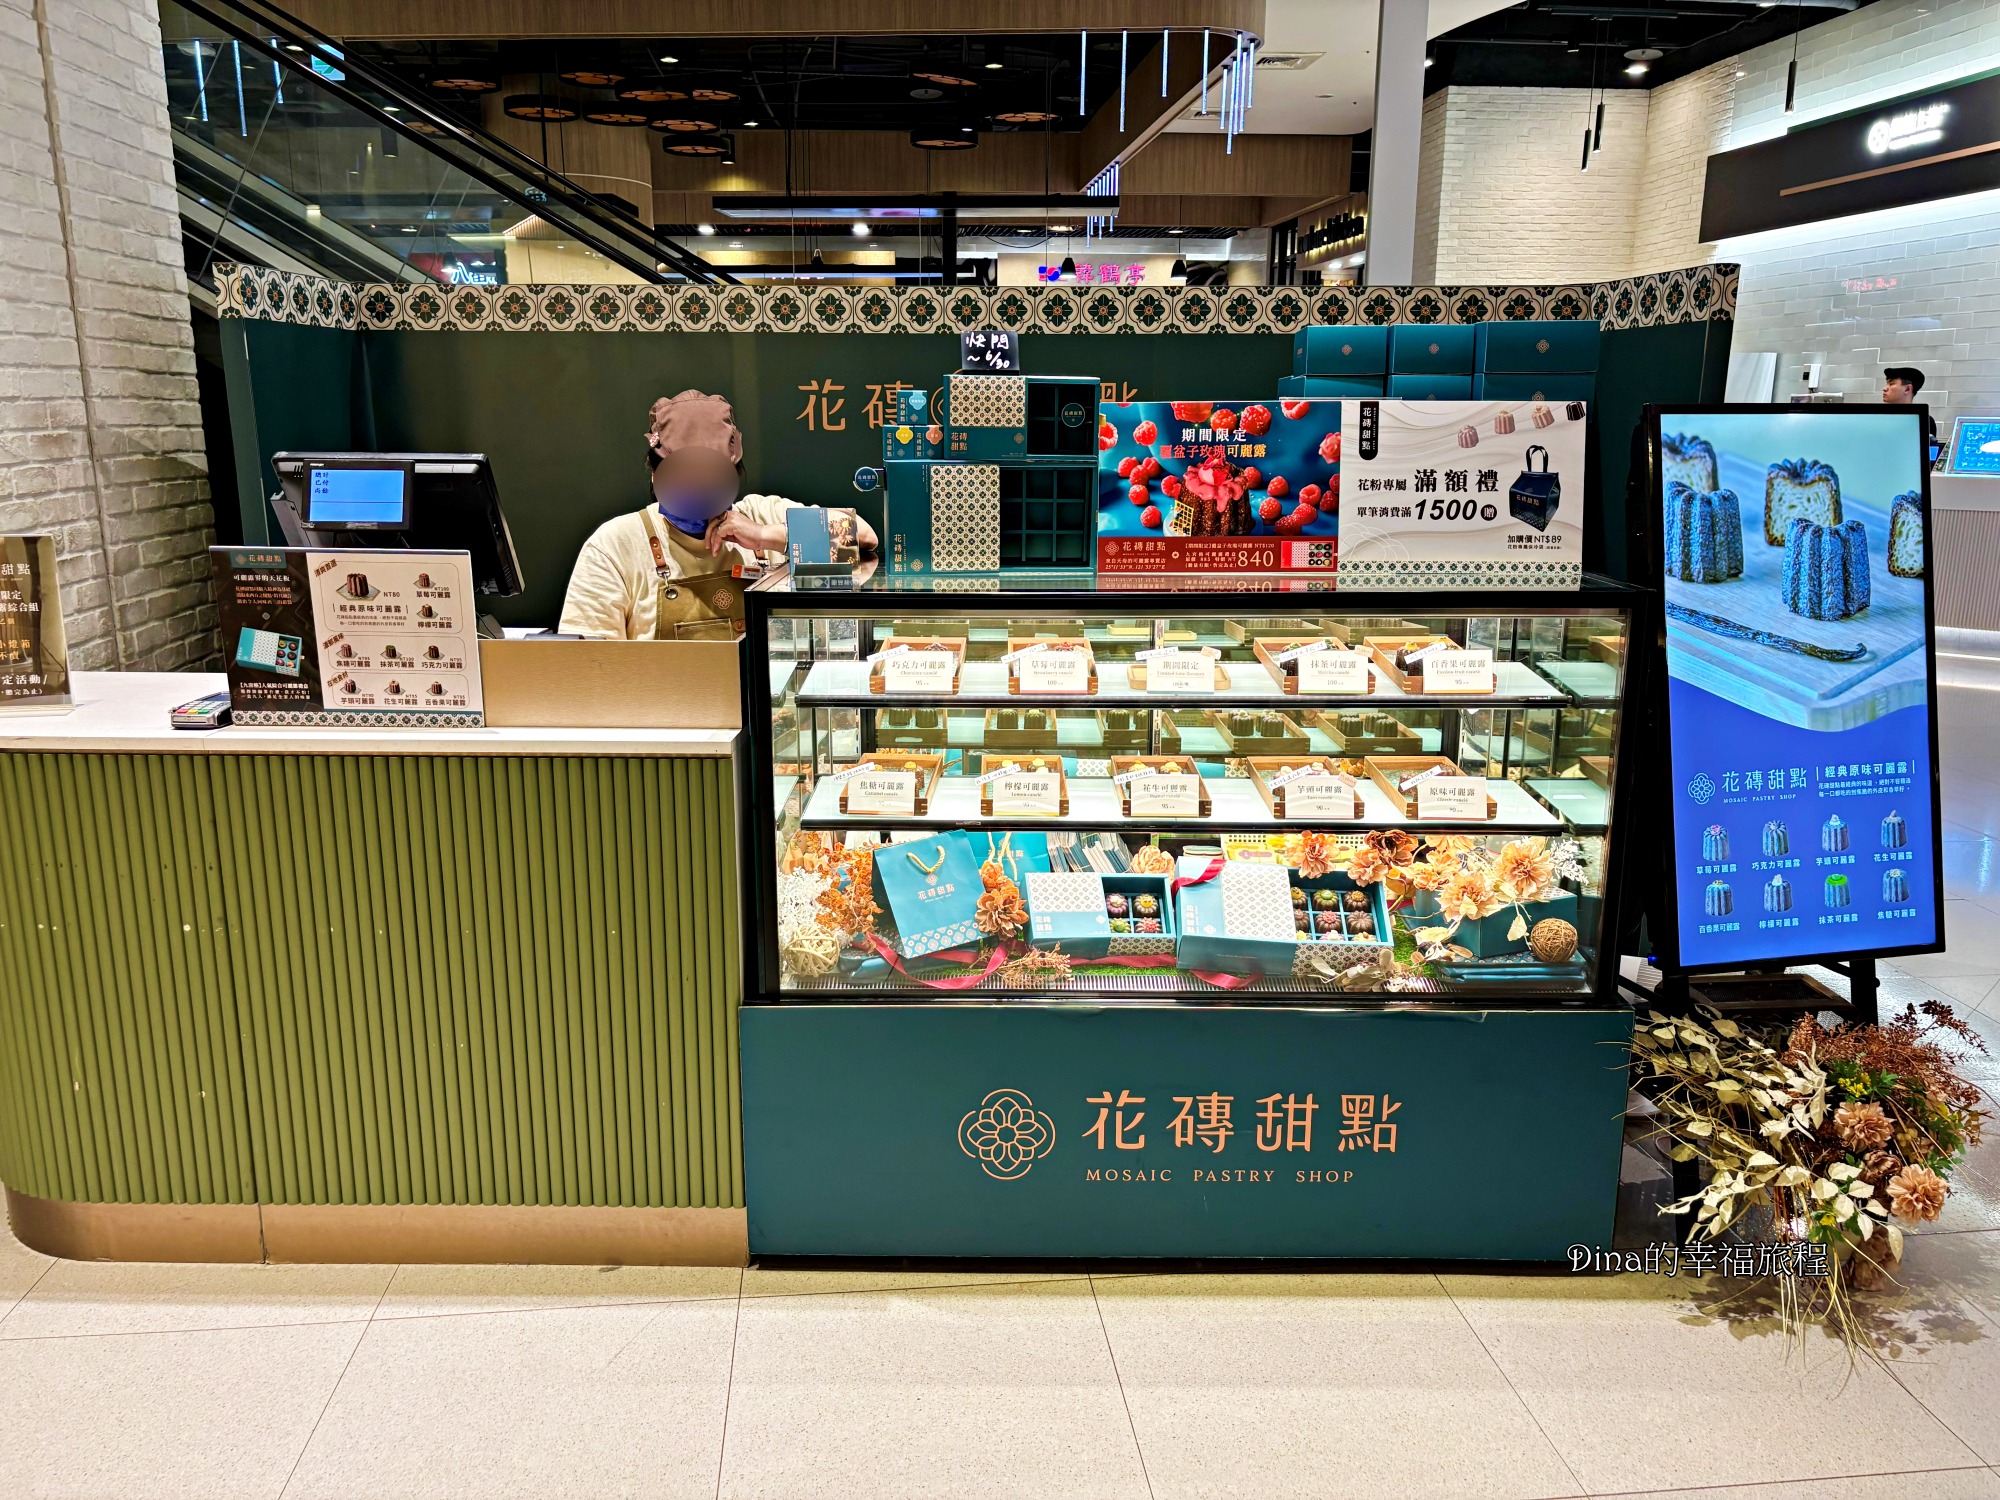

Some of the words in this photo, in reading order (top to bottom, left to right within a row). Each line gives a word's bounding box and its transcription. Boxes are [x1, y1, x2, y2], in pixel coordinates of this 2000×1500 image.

[966, 332, 1009, 349] 快閃
[985, 350, 1010, 369] 6/30
[1362, 407, 1372, 451] 花磚甜點
[1181, 428, 1247, 443] 期間限定
[1160, 444, 1267, 459] 覆盆子玫瑰可麗露
[1358, 479, 1407, 491] 花粉專屬
[1414, 469, 1499, 493] 滿額禮
[1357, 507, 1412, 518] 單筆消費滿
[1415, 499, 1477, 521] 1500
[1483, 507, 1496, 519] 贈
[1122, 541, 1166, 552] 花磚甜點
[893, 534, 902, 572] 花磚甜點
[1237, 550, 1274, 567] 840
[416, 591, 451, 599] 草莓可麗露
[339, 604, 402, 613] 經典原味可麗露
[417, 621, 453, 629] 檸檬可麗露
[336, 660, 371, 668] 焦糖可麗露
[421, 661, 463, 669] 巧克力可麗露
[892, 660, 946, 669] 巧克力可麗露
[1031, 661, 1076, 669] 草莓可麗露
[1163, 661, 1199, 670] 期間限定
[1311, 660, 1357, 669] 抹茶可麗露
[1431, 659, 1486, 668] 百香果可麗露
[341, 697, 375, 705] 芋頭可麗露
[384, 698, 418, 706] 花生可麗露
[425, 698, 466, 707] 百香果可麗露
[1721, 767, 1808, 793] 花磚甜點
[1825, 761, 1907, 778] 經典原味可麗露
[860, 781, 905, 790] 焦糖可麗露
[1004, 782, 1049, 791] 檸檬可麗露
[1143, 784, 1188, 792] 花生可麗露
[1297, 785, 1342, 794] 芋頭可麗露
[1430, 787, 1475, 797] 原味可麗露
[1815, 855, 1856, 866] 芋頭可麗露
[1873, 851, 1913, 863] 花生可麗露
[1696, 863, 1737, 875] 草莓可麗露
[1752, 858, 1801, 871] 巧克力可麗露
[917, 883, 955, 900] 花磚甜點
[1818, 913, 1859, 925] 抹茶可麗露
[1877, 908, 1917, 920] 焦糖可麗露
[1699, 922, 1741, 934] 百香果可麗露
[1759, 917, 1800, 930] 檸檬可麗露
[1081, 1089, 1403, 1153] 花磚甜點
[1085, 1169, 1173, 1182] MOSAIC
[1193, 1170, 1275, 1183] PASTRY
[1296, 1170, 1355, 1184] SHOP
